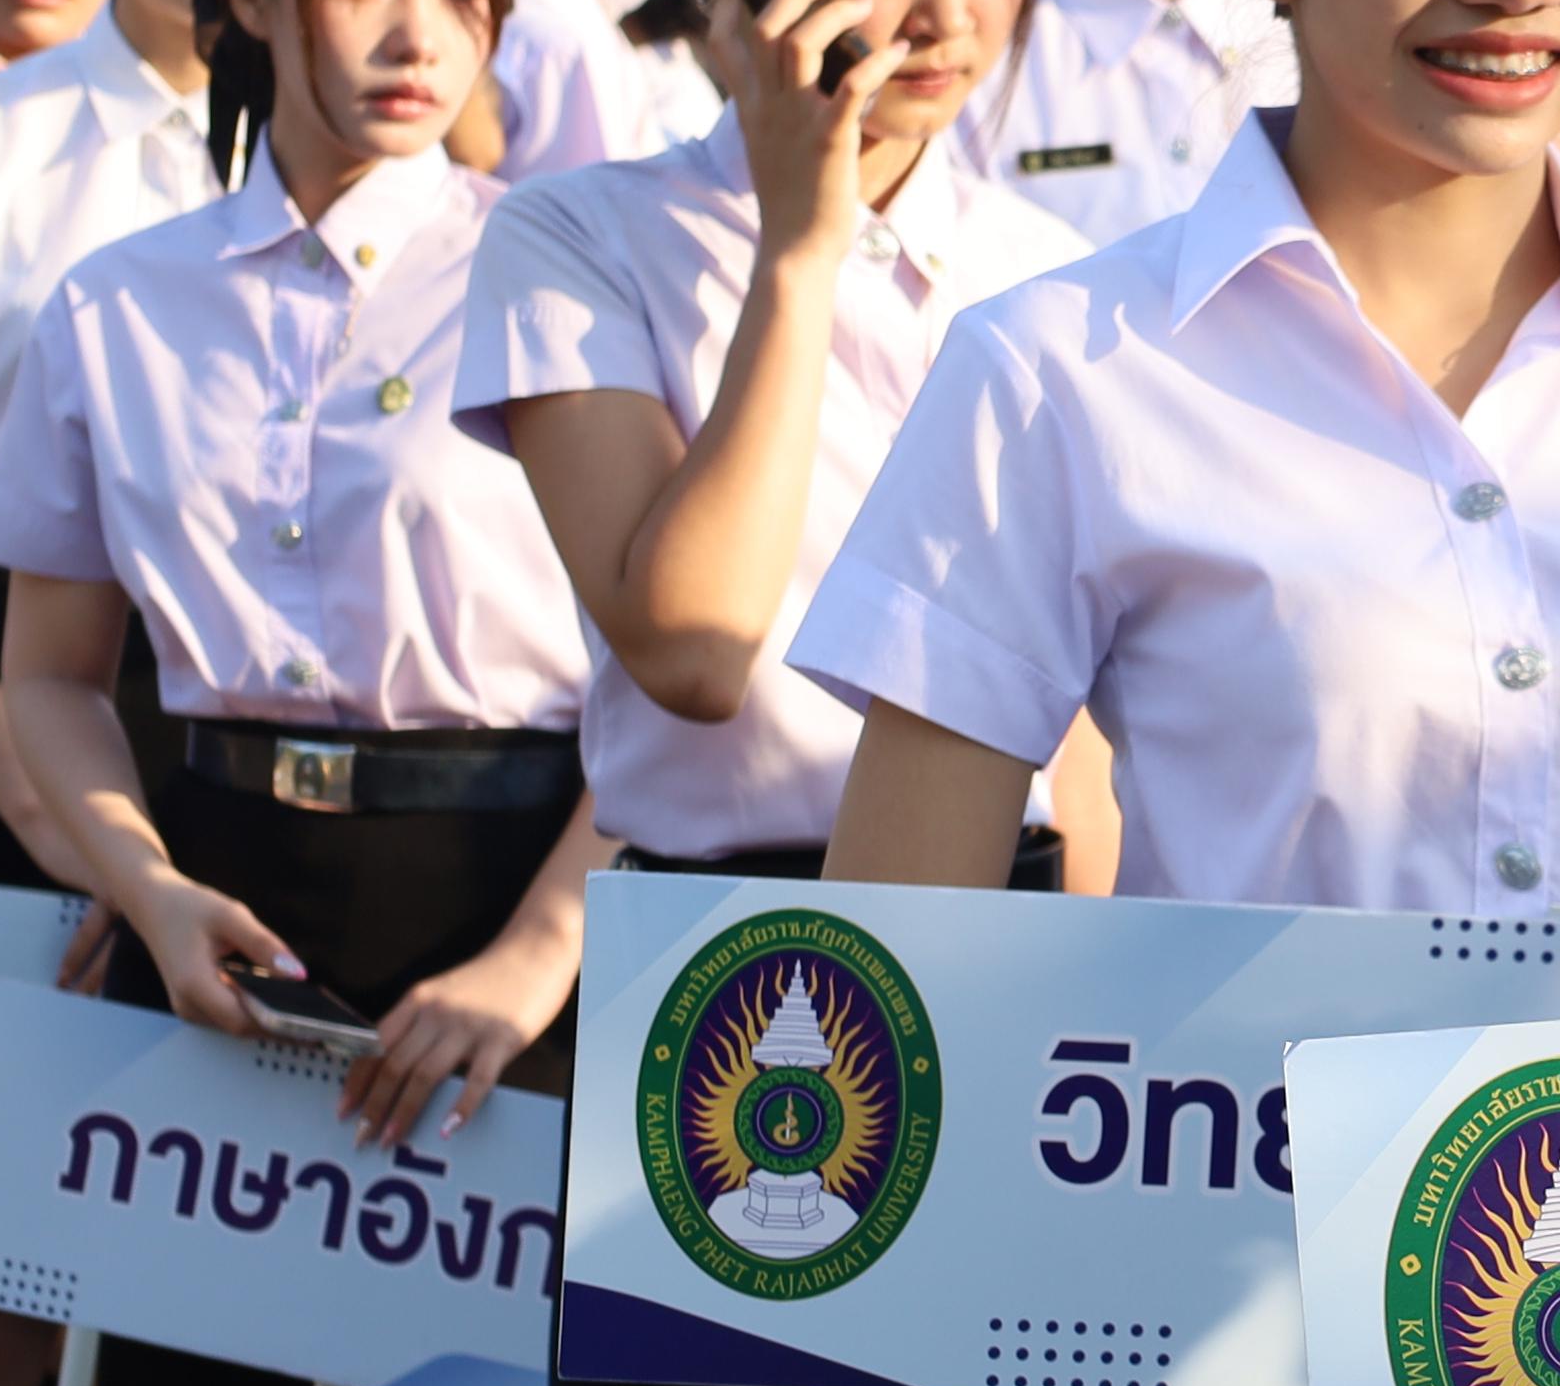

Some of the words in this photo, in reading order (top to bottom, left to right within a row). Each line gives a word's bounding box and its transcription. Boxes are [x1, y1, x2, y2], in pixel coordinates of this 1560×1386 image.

[646, 1092, 701, 1239] KAMPHAENG
[693, 1239, 748, 1283] PHET
[753, 1242, 869, 1298] RAJABHAT
[866, 1113, 933, 1245] UNIVERSITY
